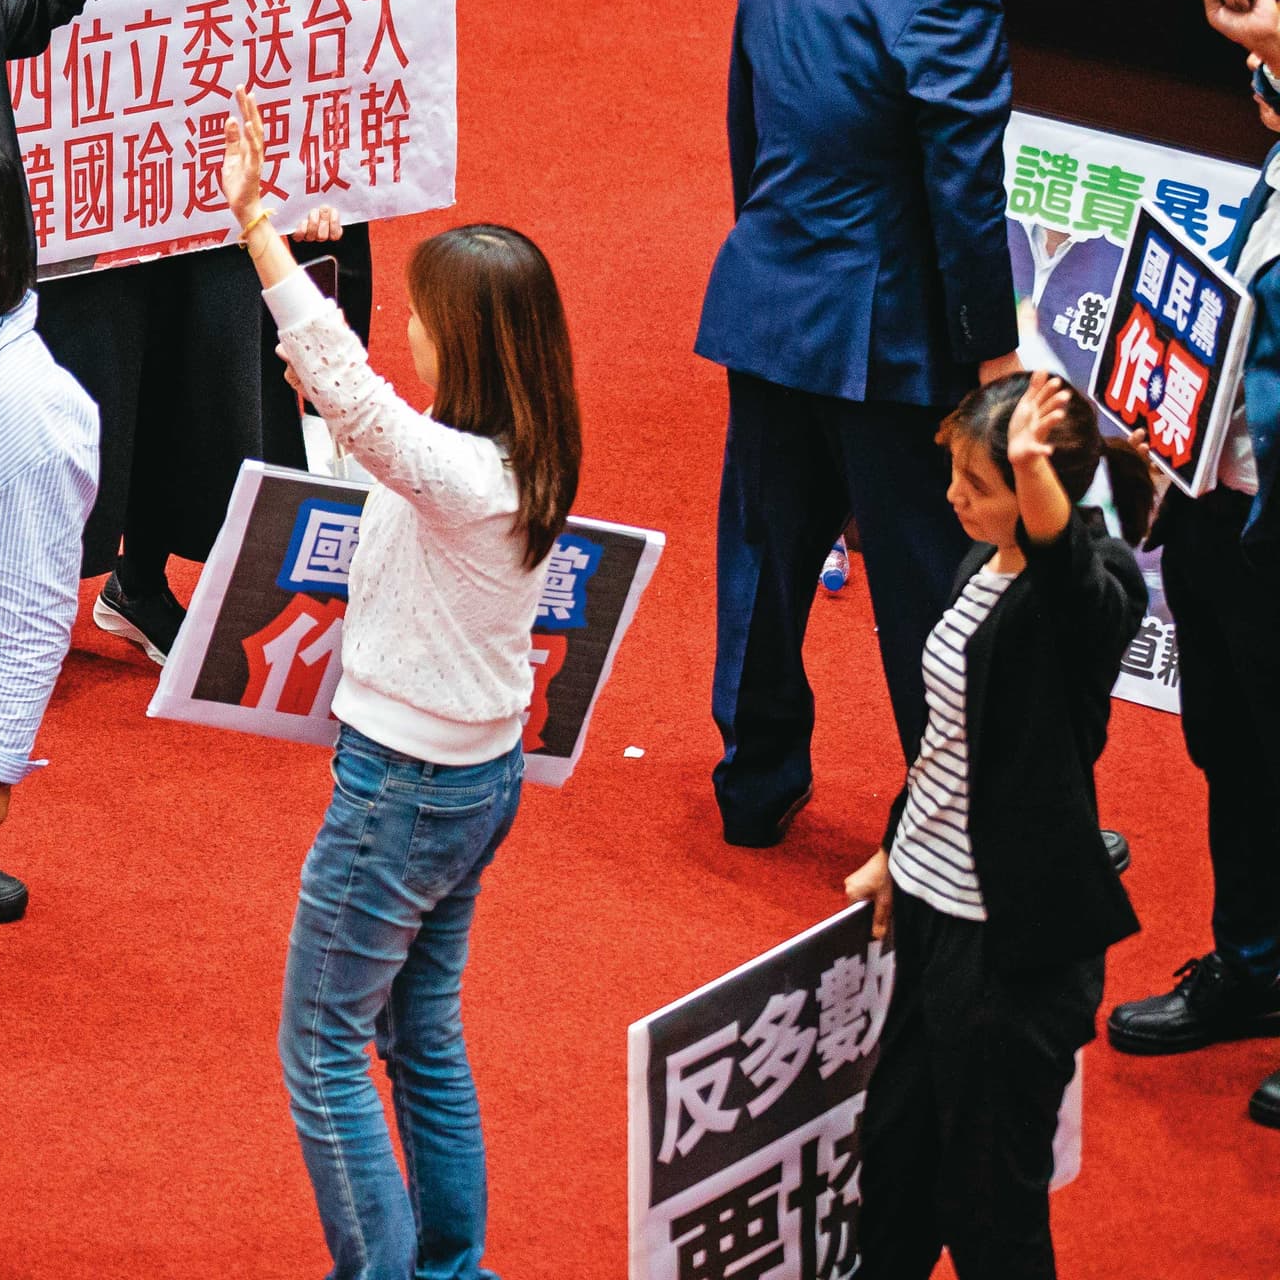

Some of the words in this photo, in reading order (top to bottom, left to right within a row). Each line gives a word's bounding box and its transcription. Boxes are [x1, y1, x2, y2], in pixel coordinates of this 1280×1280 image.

[1135, 236, 1224, 357] 國民黨
[1109, 319, 1204, 456] 作票
[289, 508, 593, 621] 國黨
